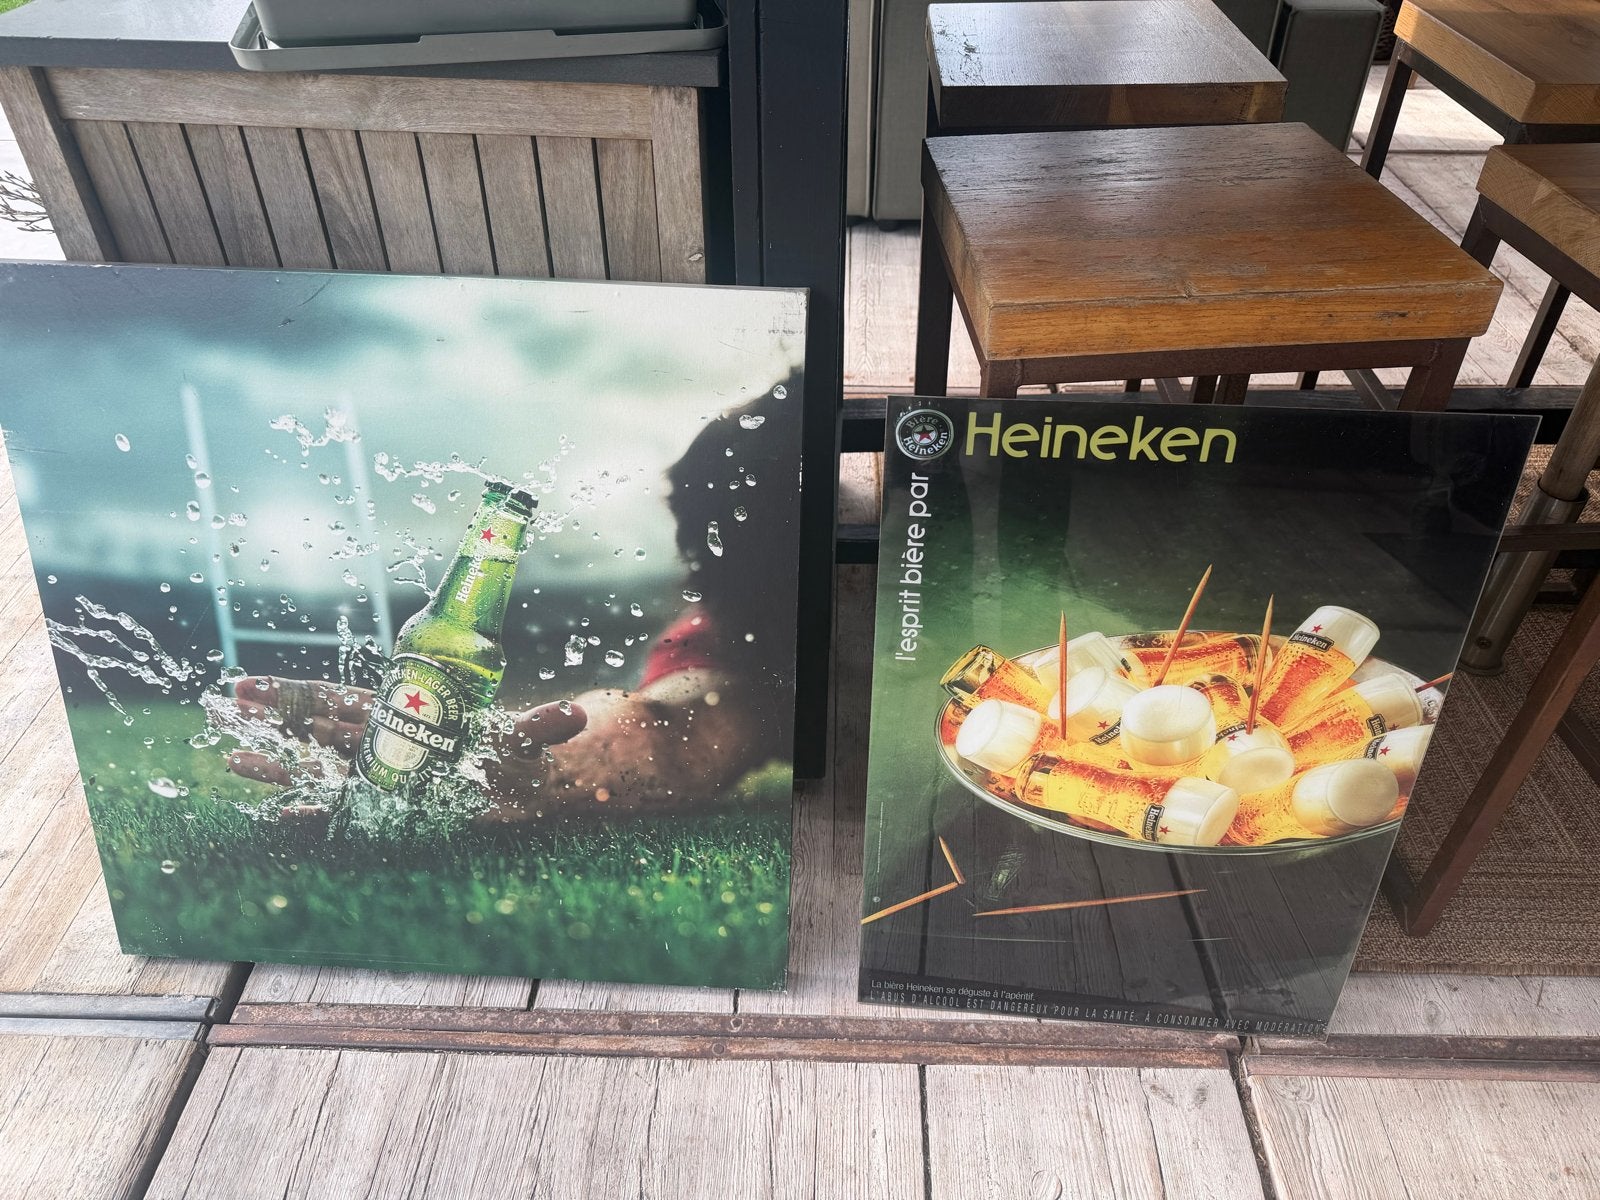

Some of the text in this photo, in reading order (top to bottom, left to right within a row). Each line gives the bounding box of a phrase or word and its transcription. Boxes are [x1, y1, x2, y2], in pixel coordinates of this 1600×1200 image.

[903, 431, 949, 455] Heineken
[905, 415, 939, 428] Bière
[966, 411, 1237, 463] Heineken
[895, 472, 932, 661] l'esprit bière par
[420, 674, 451, 698] LAGER
[446, 698, 459, 721] BEER
[363, 737, 388, 778] PREMIUM
[391, 765, 433, 784] QUITY
[870, 990, 905, 1003] L'ABUS
[911, 993, 960, 1007] D'ALCOOL
[967, 998, 984, 1009] EST
[991, 1000, 1048, 1014] DANGEREUX
[1054, 1005, 1079, 1016] POUR
[1085, 1008, 1097, 1018] LA
[1103, 1009, 1138, 1022] SANTÉ.
[1157, 1013, 1219, 1028] CONSOMMER
[1224, 1019, 1250, 1030] AVEC
[871, 980, 881, 988] La
[884, 981, 904, 990] bière
[907, 982, 944, 994] Heineken
[946, 986, 956, 995] se
[958, 987, 991, 998] déguste
[993, 990, 999, 998] à
